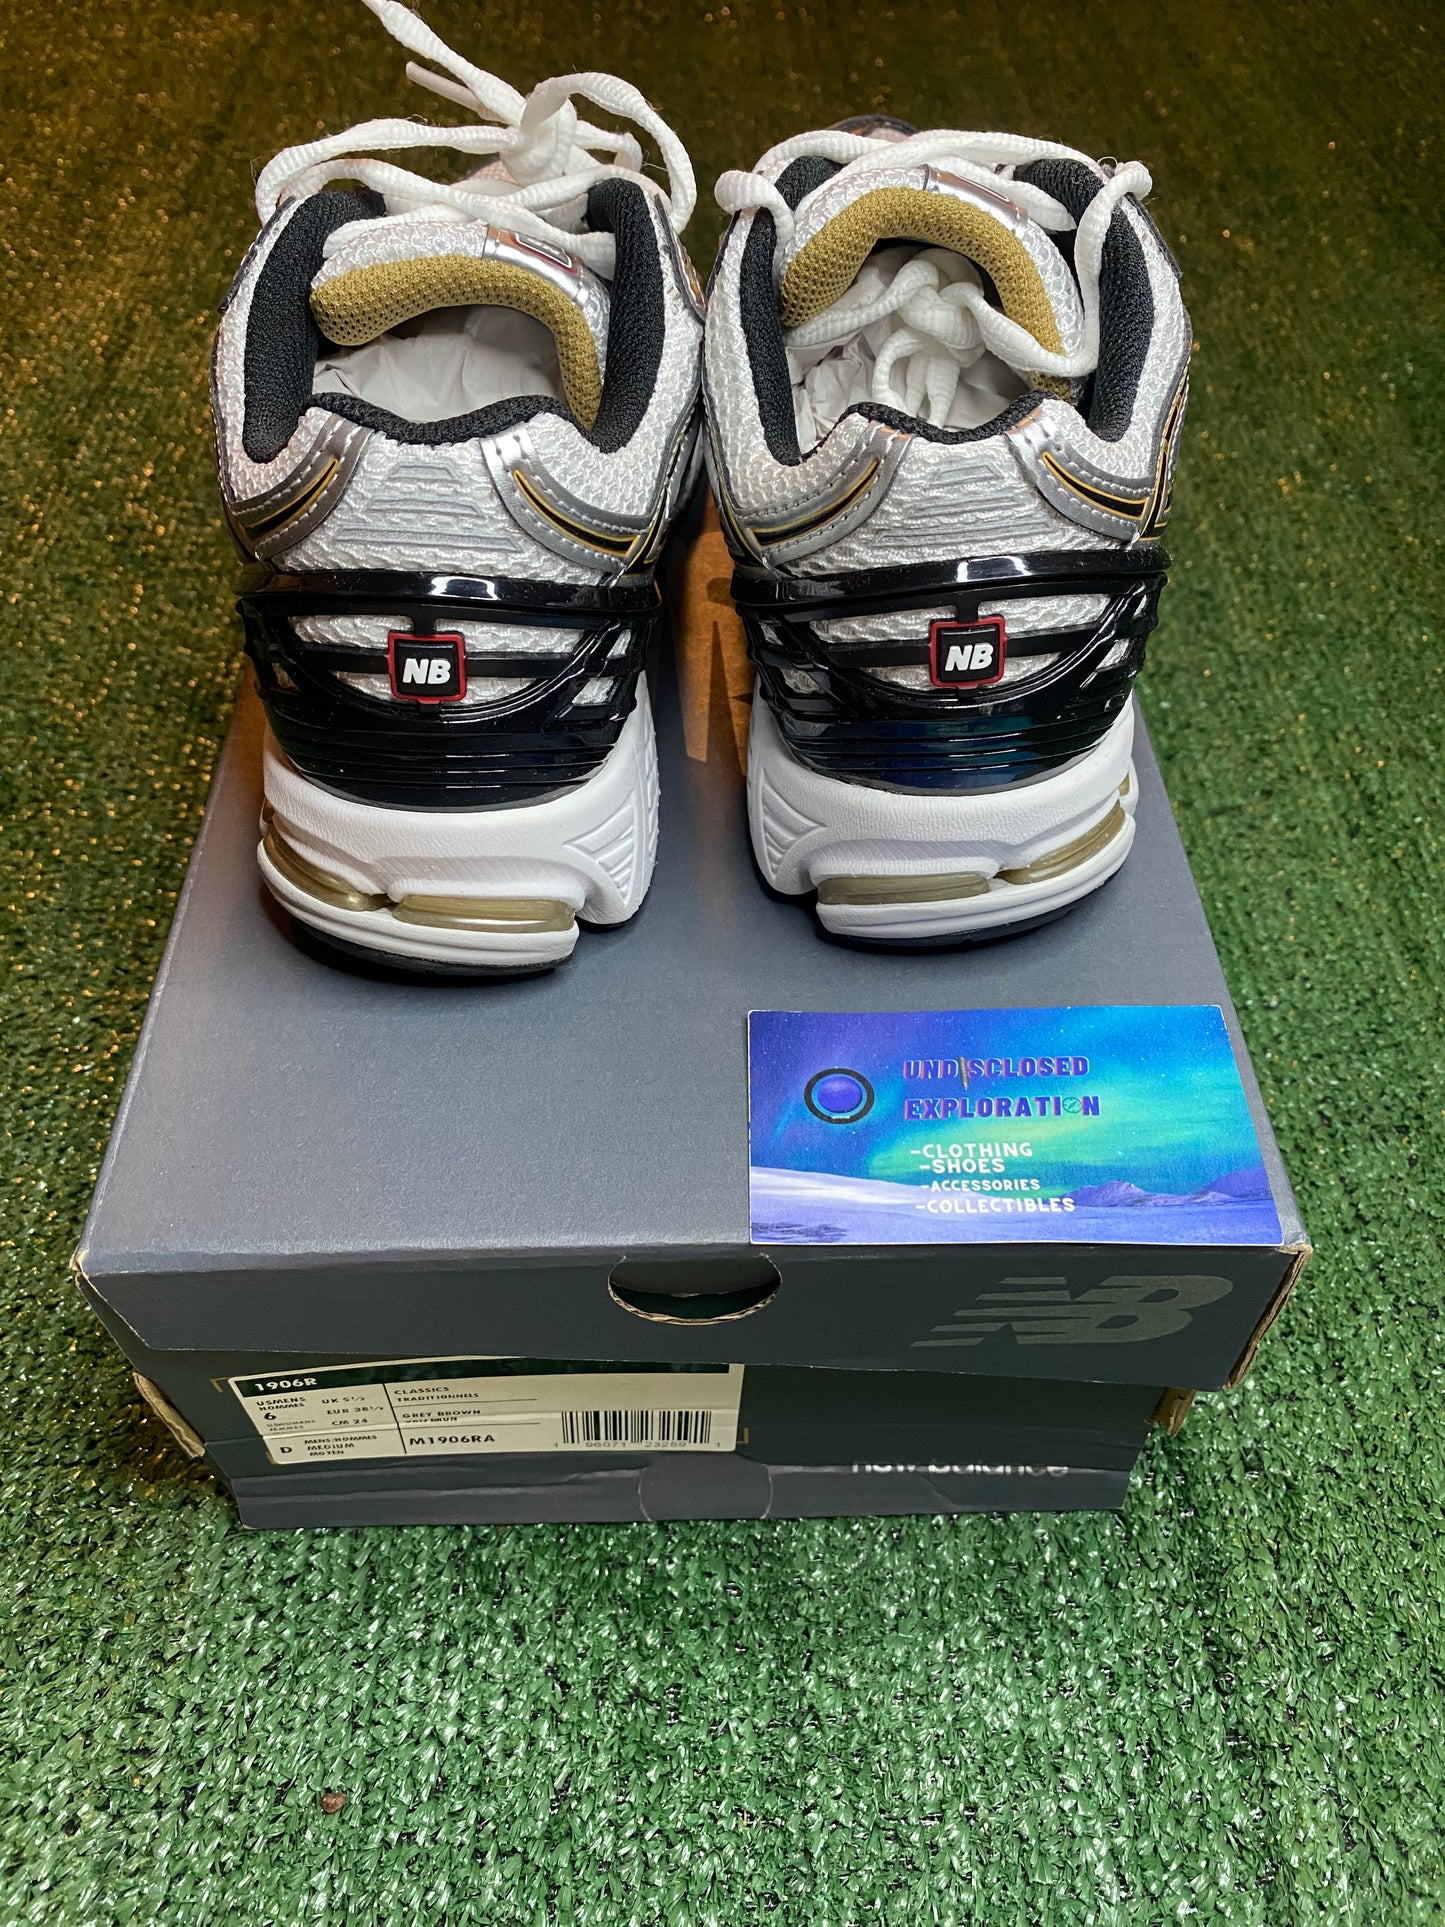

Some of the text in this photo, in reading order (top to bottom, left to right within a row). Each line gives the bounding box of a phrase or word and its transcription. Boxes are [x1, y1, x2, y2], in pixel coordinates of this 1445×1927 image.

[944, 642, 994, 671] NB
[402, 658, 451, 685] NB
[910, 1142, 1033, 1159] -CLOTHING
[919, 1158, 1006, 1174] -SHOES
[921, 1179, 1041, 1193] -ACCESSORIES
[916, 1198, 1076, 1213] -COLLECTIBLES
[255, 1377, 318, 1391] 1906R
[394, 1386, 450, 1395] CLASSICS
[256, 1396, 307, 1406] USMENS
[397, 1393, 480, 1402] TRADITIONNELS
[259, 1403, 305, 1411] HOMMES
[264, 1412, 277, 1420] 6
[409, 1434, 496, 1445] M1906RA
[279, 1446, 293, 1454] D
[307, 1442, 356, 1451] MEDIUM
